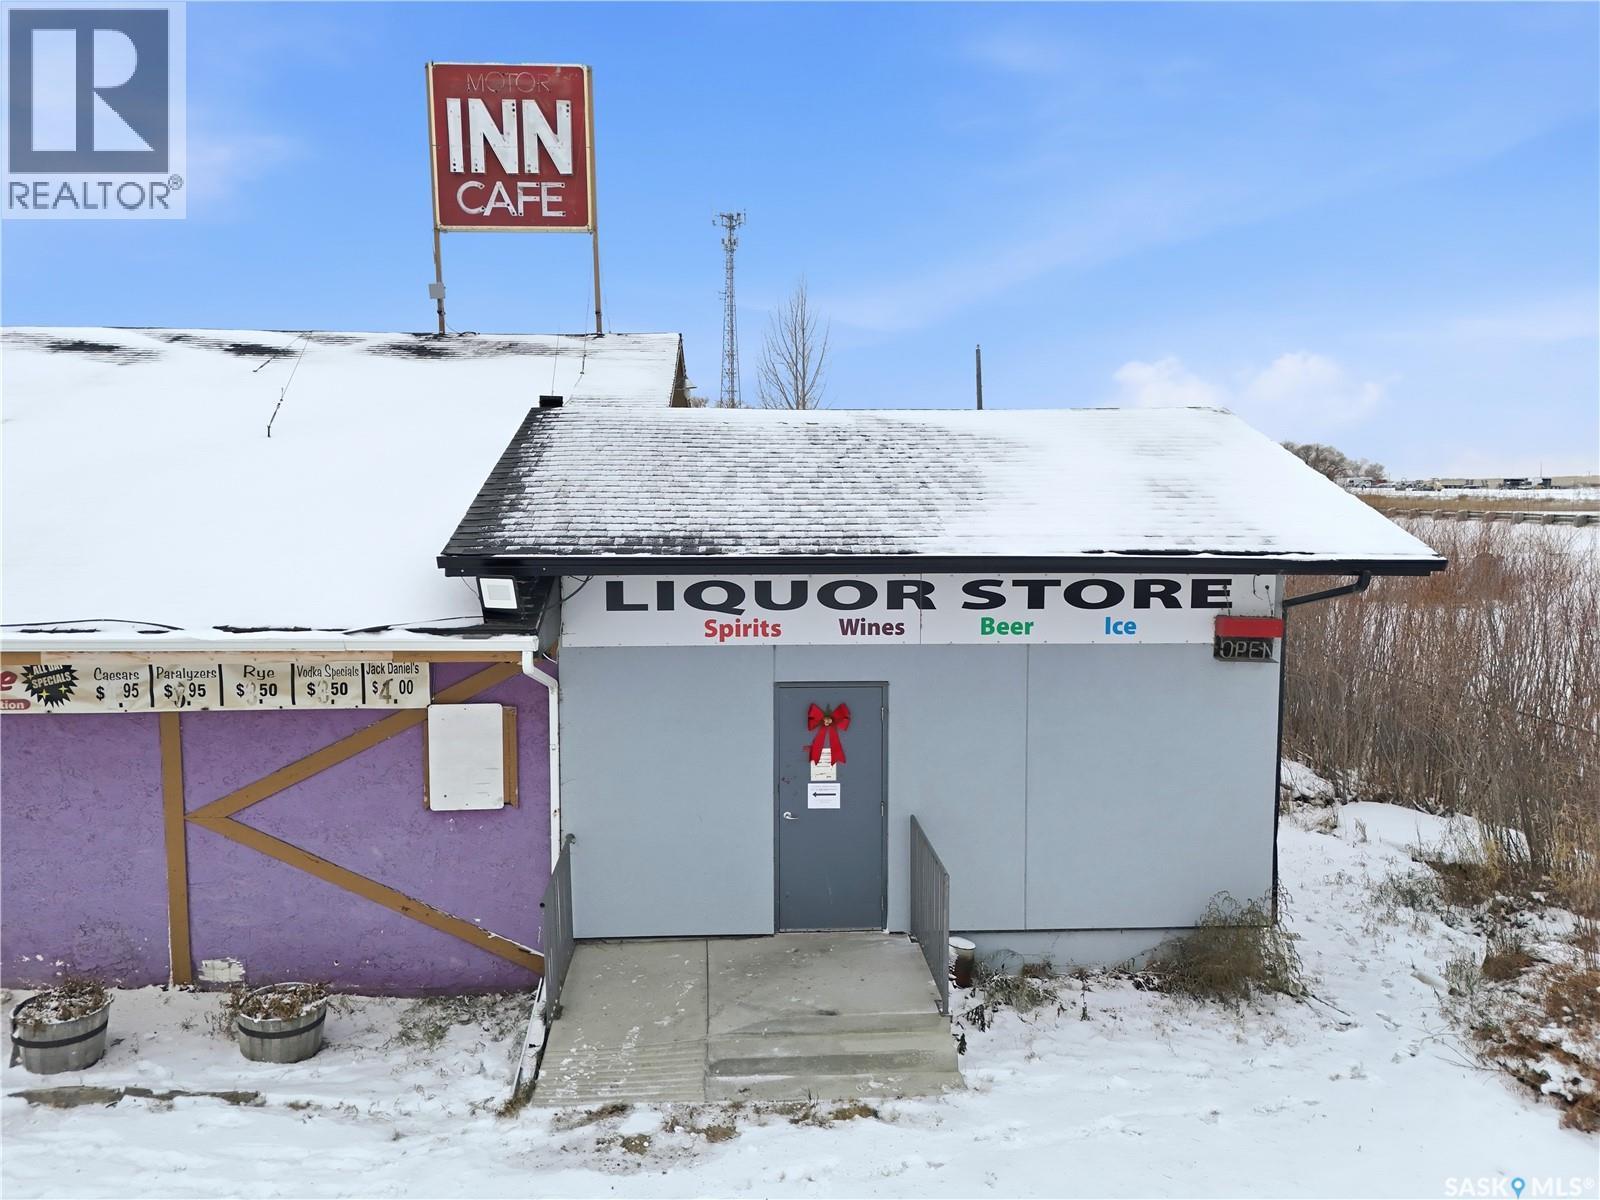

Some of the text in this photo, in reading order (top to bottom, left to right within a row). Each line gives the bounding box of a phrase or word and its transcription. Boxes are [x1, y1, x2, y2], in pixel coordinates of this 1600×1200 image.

[466, 71, 552, 93] MOTOR
[446, 97, 573, 175] INN
[456, 180, 567, 217] CAFE
[605, 578, 1233, 616] LIQUOR STORE
[704, 616, 1137, 642] Spirits Wines Beer Ice
[1219, 640, 1272, 659] OPEN
[33, 664, 48, 675] ALL
[93, 667, 140, 681] Caesars
[156, 666, 217, 682] Paralyzers
[243, 665, 275, 681] Rye
[296, 664, 359, 680] Vodka Specials
[366, 662, 420, 675] Jack Daniel's
[31, 671, 72, 689] SPECIALS
